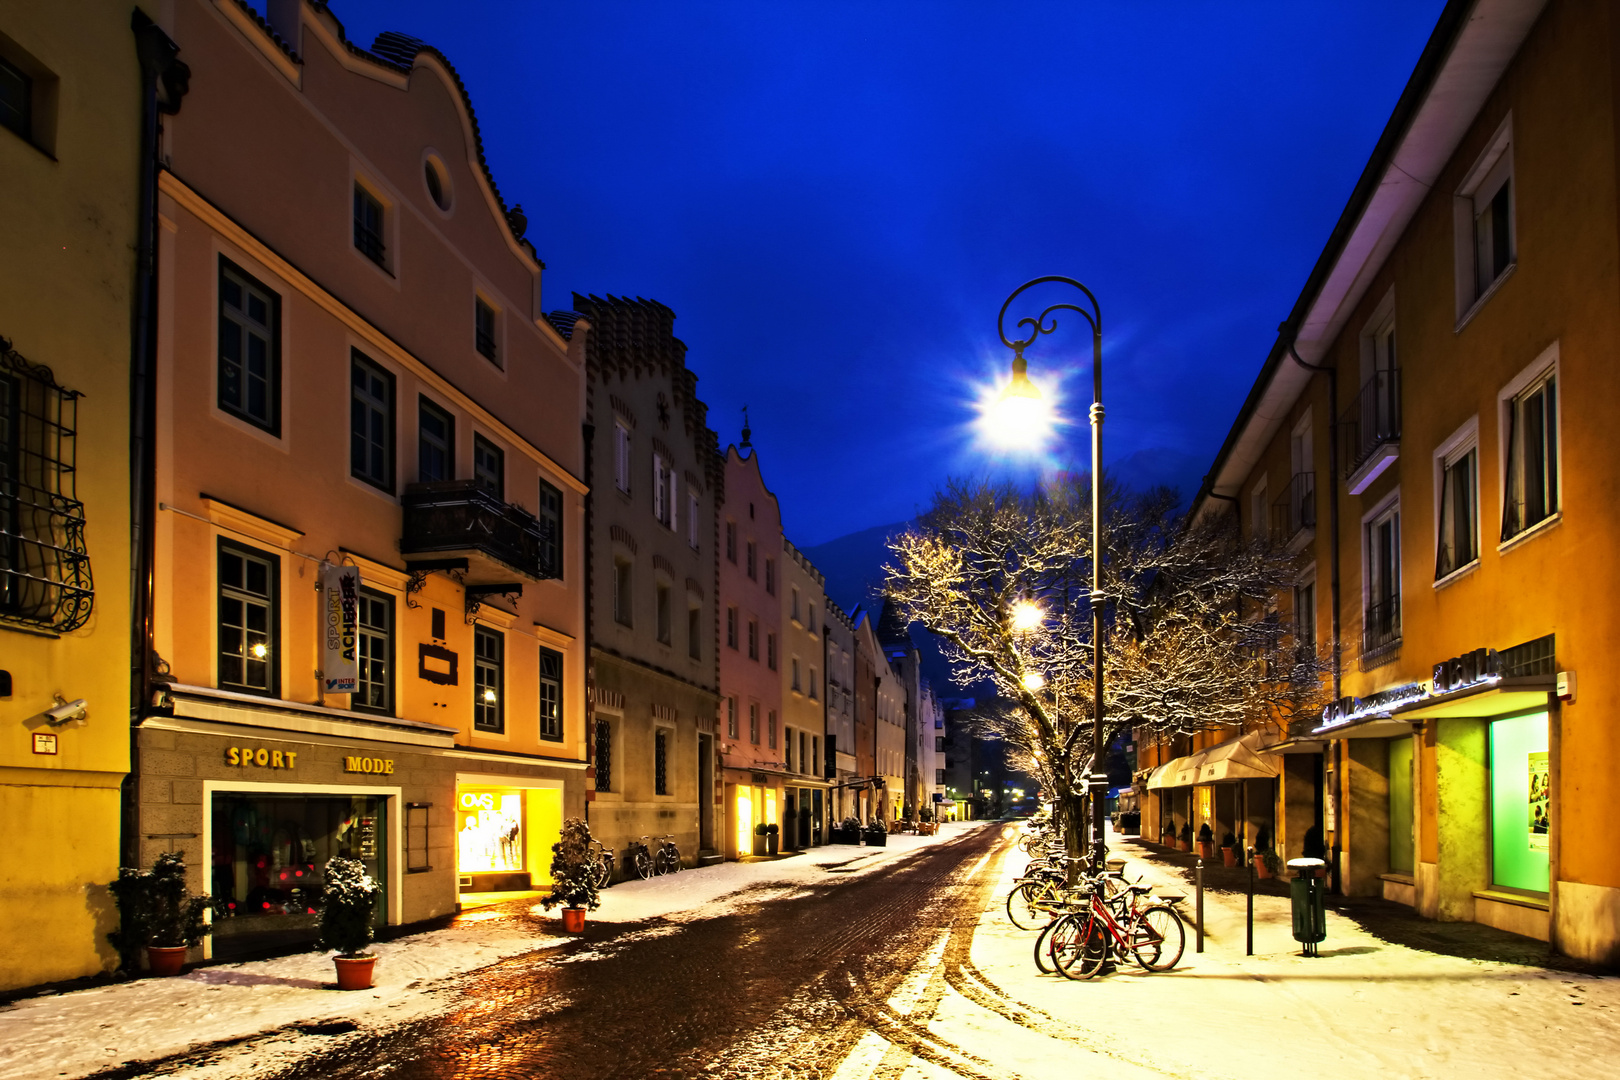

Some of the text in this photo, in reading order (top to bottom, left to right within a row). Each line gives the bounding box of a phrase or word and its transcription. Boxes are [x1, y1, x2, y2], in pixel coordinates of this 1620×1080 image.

[327, 587, 340, 650] SPORT
[228, 747, 297, 769] SPORT
[346, 756, 394, 774] MODE
[461, 793, 494, 809] OVS
